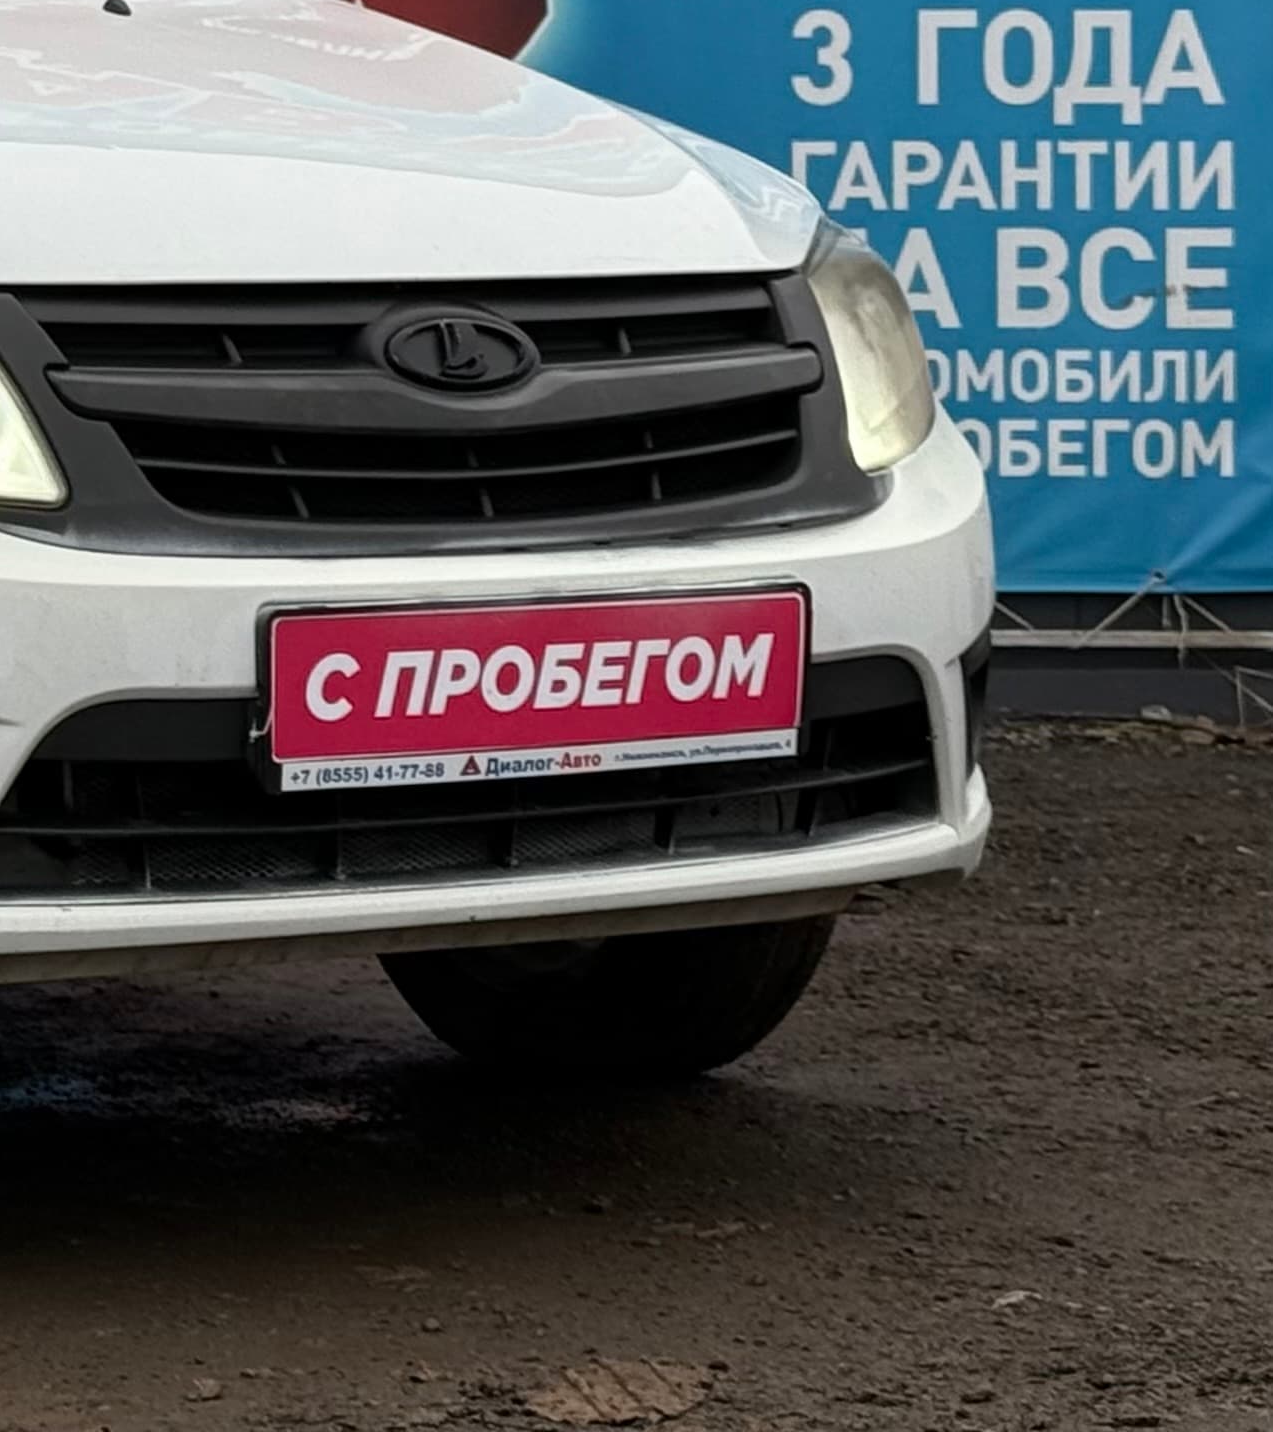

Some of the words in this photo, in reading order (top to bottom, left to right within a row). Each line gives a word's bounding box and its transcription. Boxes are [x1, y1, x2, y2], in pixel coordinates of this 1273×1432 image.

[791, 9, 853, 106] 3
[917, 8, 1225, 126] ГОДА
[791, 140, 1234, 211] ГАРАНТИИ
[853, 227, 962, 329] А
[996, 227, 1234, 330] ВСЕ
[305, 653, 361, 721] С
[374, 633, 774, 718] ПРОБЕГОМ
[290, 769, 310, 785] +7
[316, 766, 369, 786] (8555)
[485, 752, 602, 776] Диалог-Авто
